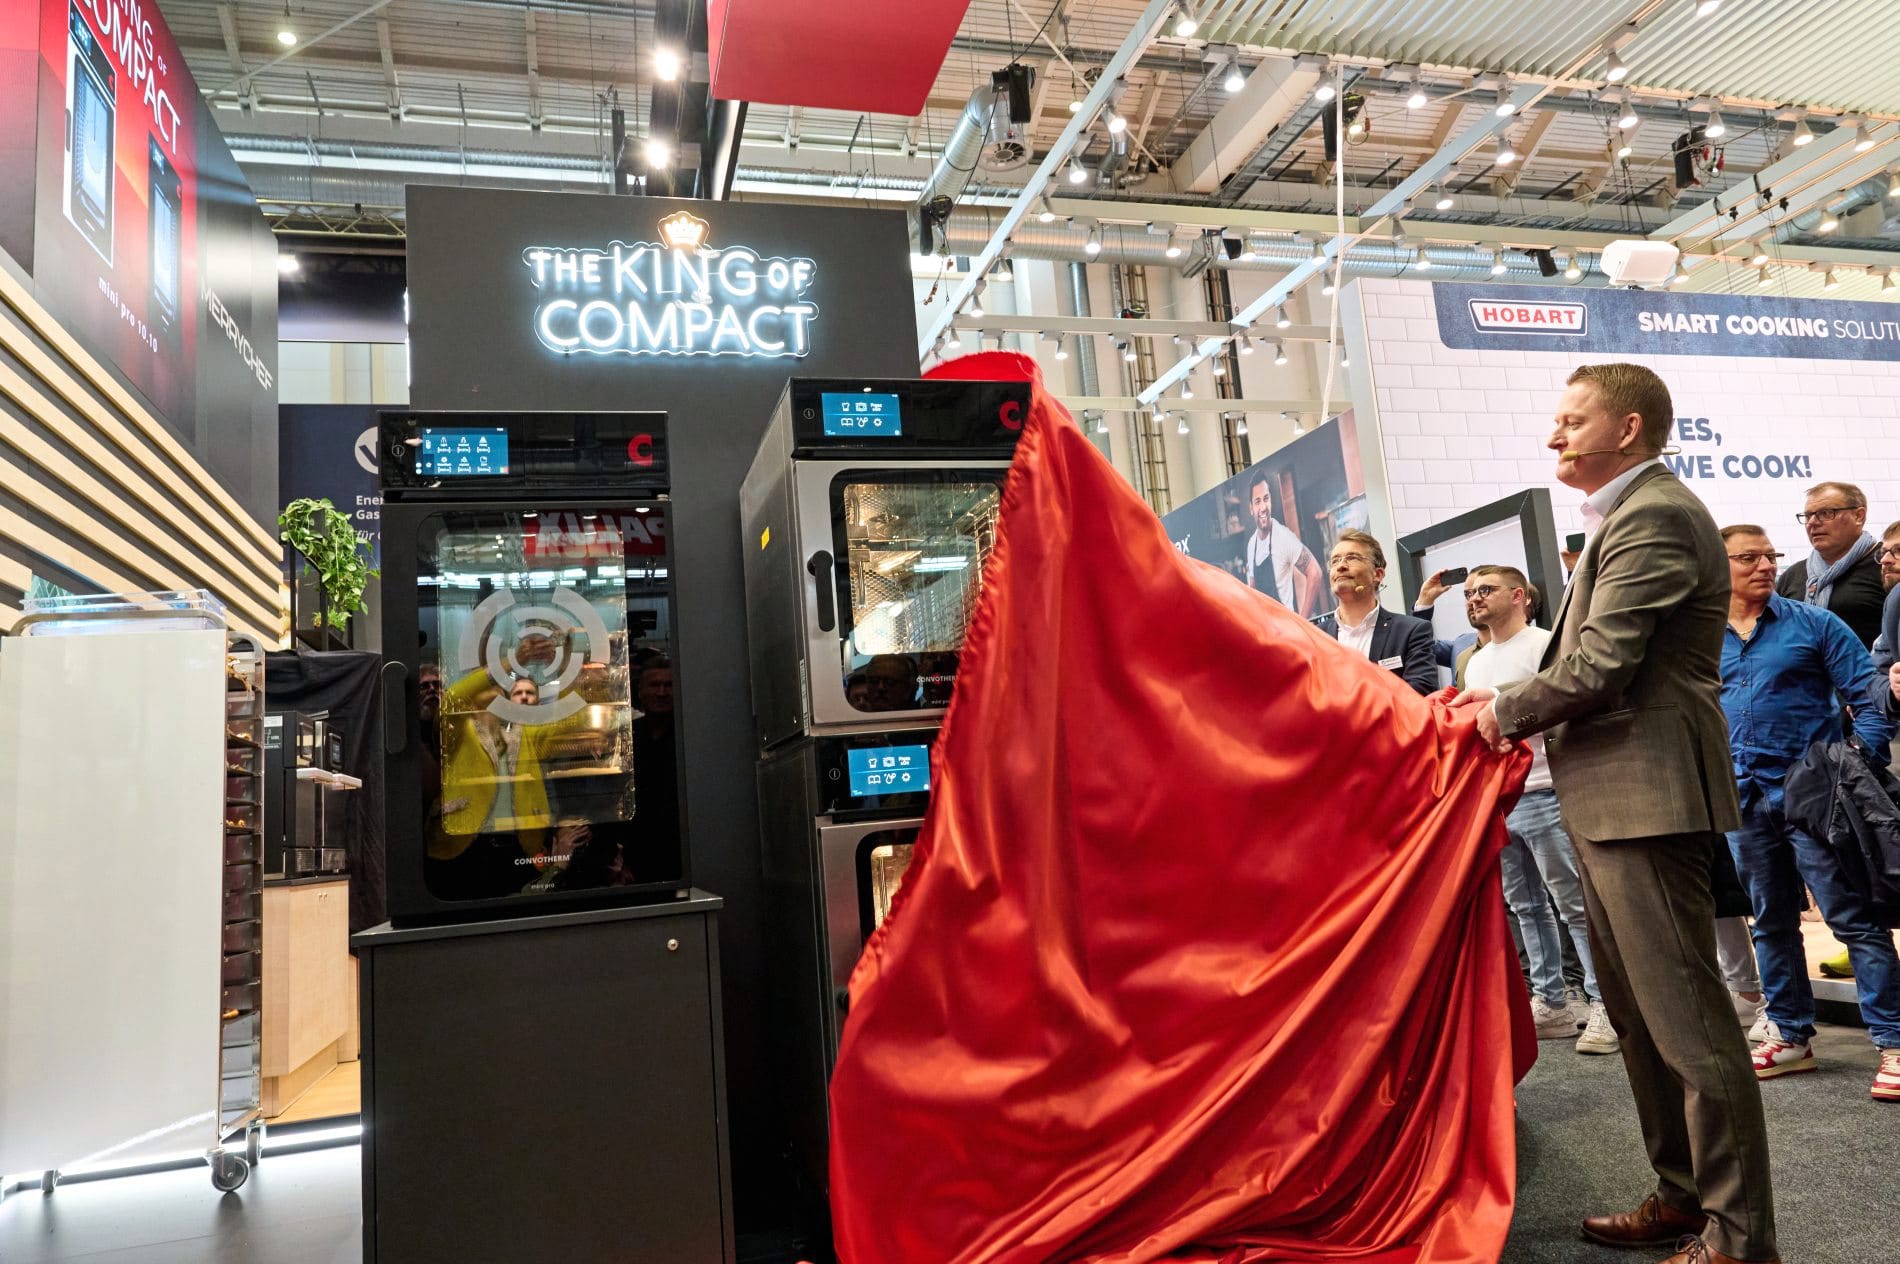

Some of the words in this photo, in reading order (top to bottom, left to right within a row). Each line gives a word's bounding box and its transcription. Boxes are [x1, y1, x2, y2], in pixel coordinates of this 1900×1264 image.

[84, 0, 181, 156] OMPACT
[157, 55, 167, 77] OF
[529, 250, 601, 284] THE
[613, 246, 758, 298] KING
[767, 261, 811, 291] OF
[98, 276, 118, 308] mini
[121, 302, 135, 328] pro
[138, 319, 158, 353] 10.10
[539, 299, 813, 352] COMPACT
[1483, 307, 1576, 325] HOBART
[1638, 311, 1720, 334] SMART
[1725, 314, 1828, 338] COOKING
[1833, 319, 1900, 340] SOLUTI
[200, 276, 273, 392] MERRYCHEF
[1670, 417, 1722, 446] ES,
[1665, 455, 1716, 479] WE
[1722, 454, 1813, 479] COOK!
[514, 854, 570, 866] CONVOTHERM
